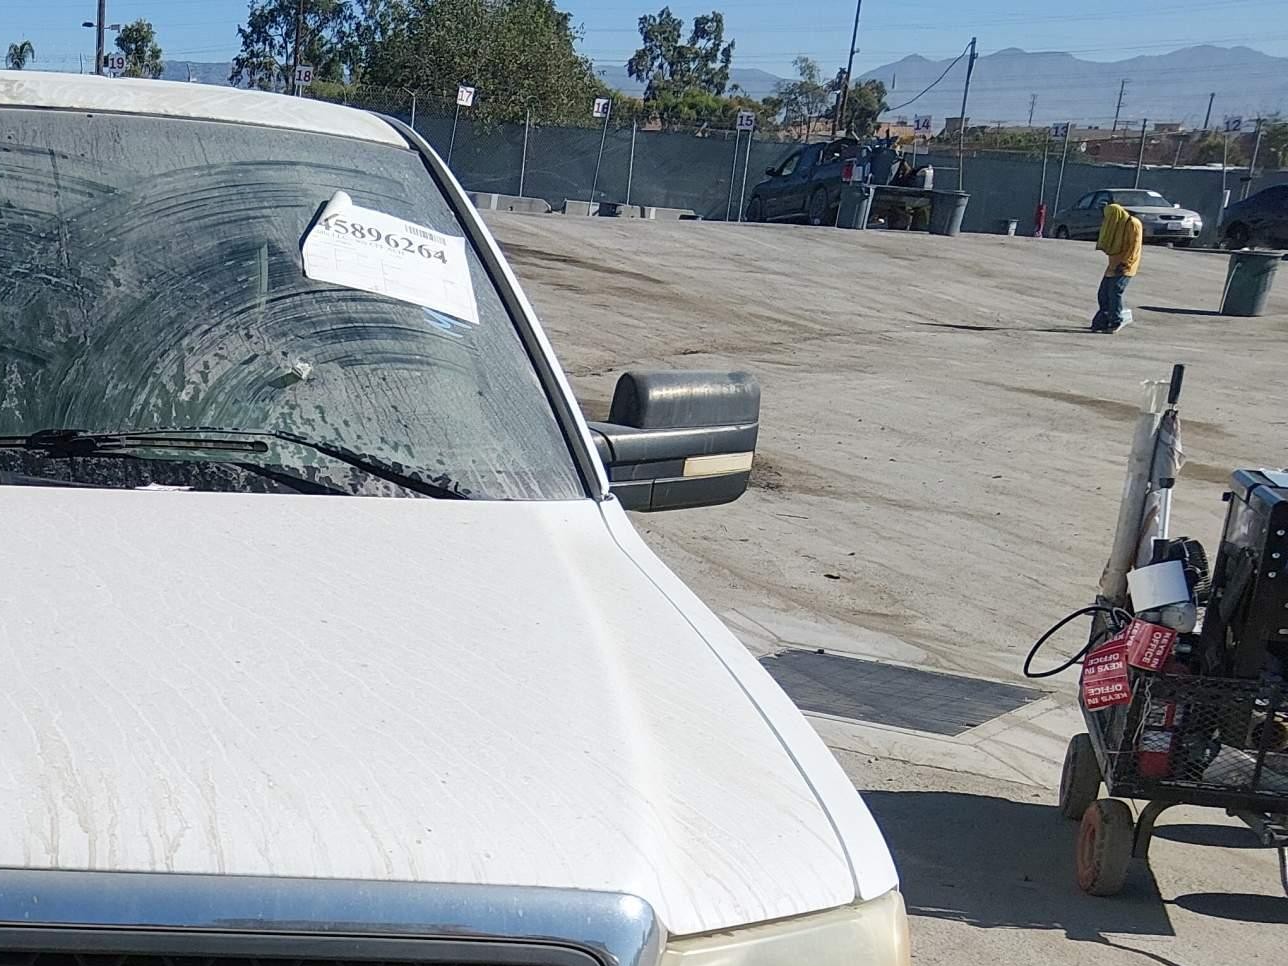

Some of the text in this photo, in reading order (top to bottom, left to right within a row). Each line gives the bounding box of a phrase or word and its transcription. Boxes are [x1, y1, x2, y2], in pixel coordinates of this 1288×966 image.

[109, 57, 125, 70] 19
[296, 70, 311, 82] 18
[458, 89, 473, 102] 17
[595, 102, 610, 115] 16
[739, 114, 754, 127] 15
[914, 118, 931, 131] 14
[1224, 119, 1242, 132] 12
[319, 213, 448, 264] 45896264
[1142, 631, 1162, 664] OFFICE
[1157, 632, 1172, 657] KEYS
[1088, 653, 1120, 666] OFFICE
[1097, 661, 1123, 673] KEYS
[1088, 683, 1123, 696] OFFICE
[1101, 692, 1128, 701] KEYS
